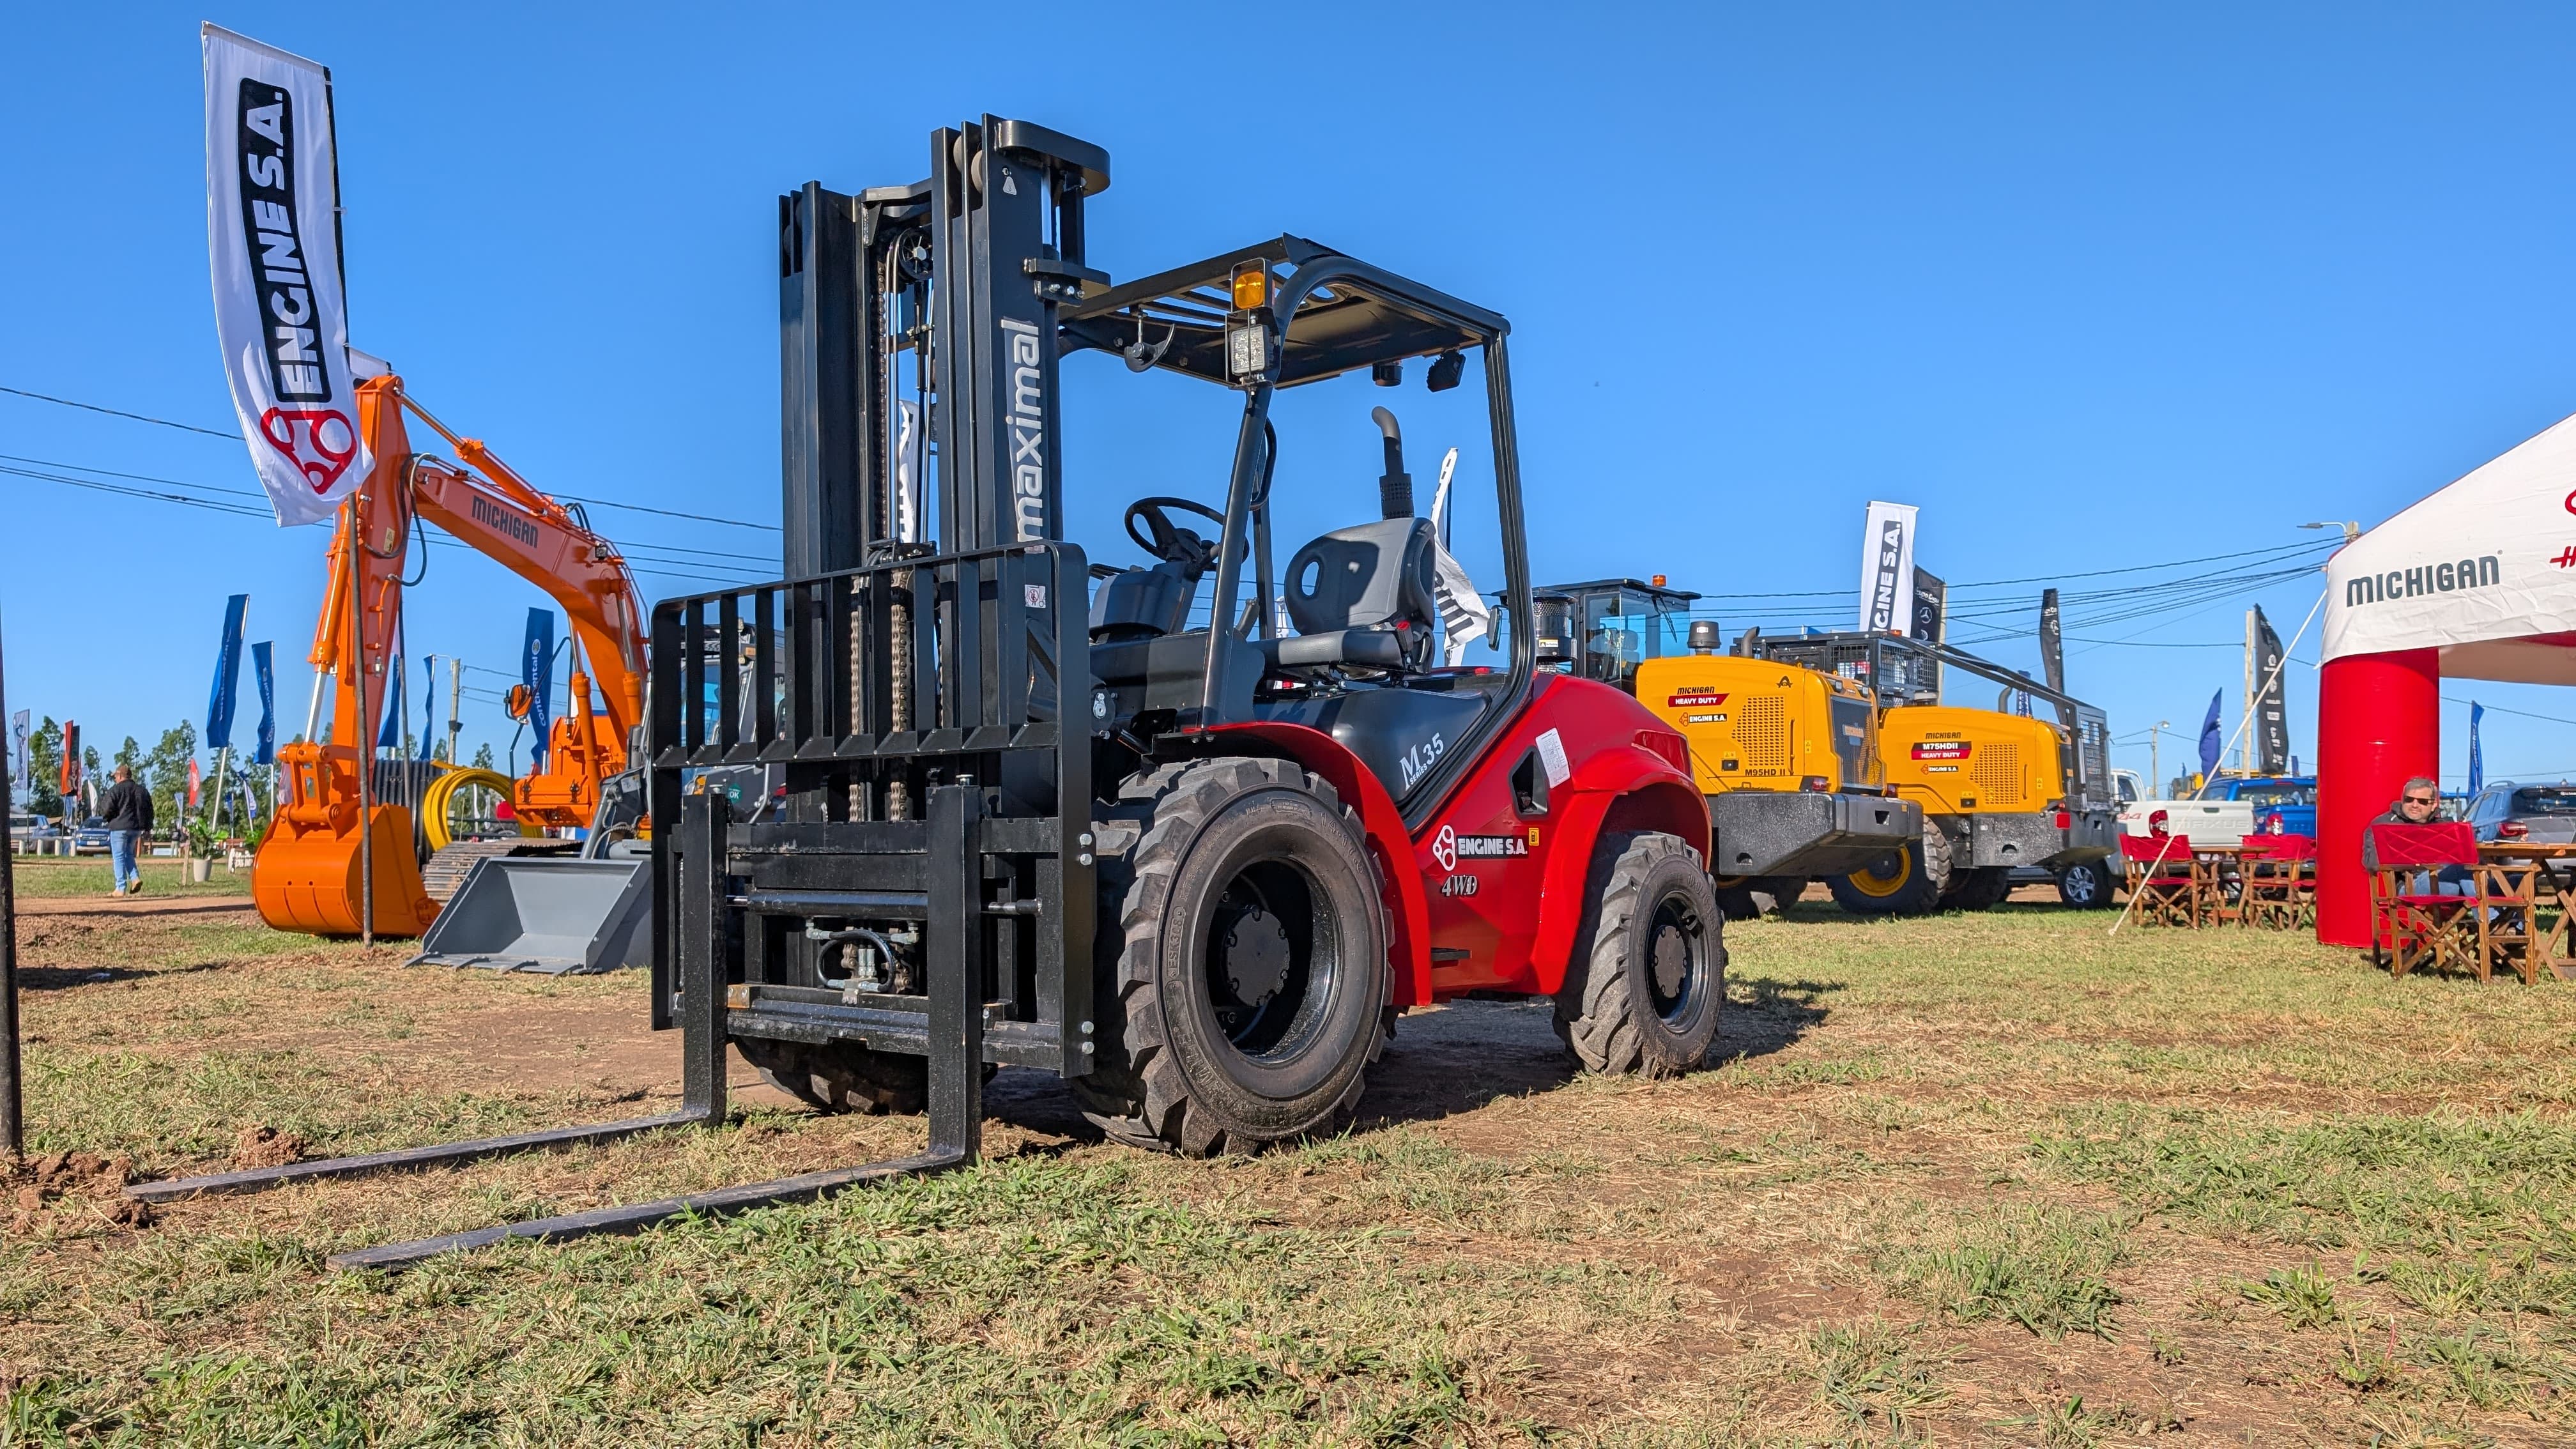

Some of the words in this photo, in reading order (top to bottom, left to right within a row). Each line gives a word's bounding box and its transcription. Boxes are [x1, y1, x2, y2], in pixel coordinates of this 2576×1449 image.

[246, 91, 285, 190] S.A.
[252, 200, 323, 394] ENGINE
[1001, 319, 1043, 542] maximal
[472, 495, 538, 548] MICHIGAN
[1872, 572, 1894, 631] GINE
[1883, 524, 1901, 567] S.A.
[2347, 555, 2500, 608] MICHIGAN
[1677, 686, 1715, 694] MICHIGAN
[1399, 744, 1421, 792] M
[1423, 732, 1444, 765] 35
[1409, 763, 1428, 785] SERIES
[729, 791, 739, 799] OK
[1457, 838, 1503, 855] ENGINE
[1505, 838, 1528, 855] S.A.
[2175, 818, 2250, 829] MAXUS
[1441, 875, 1478, 896] 4WD
